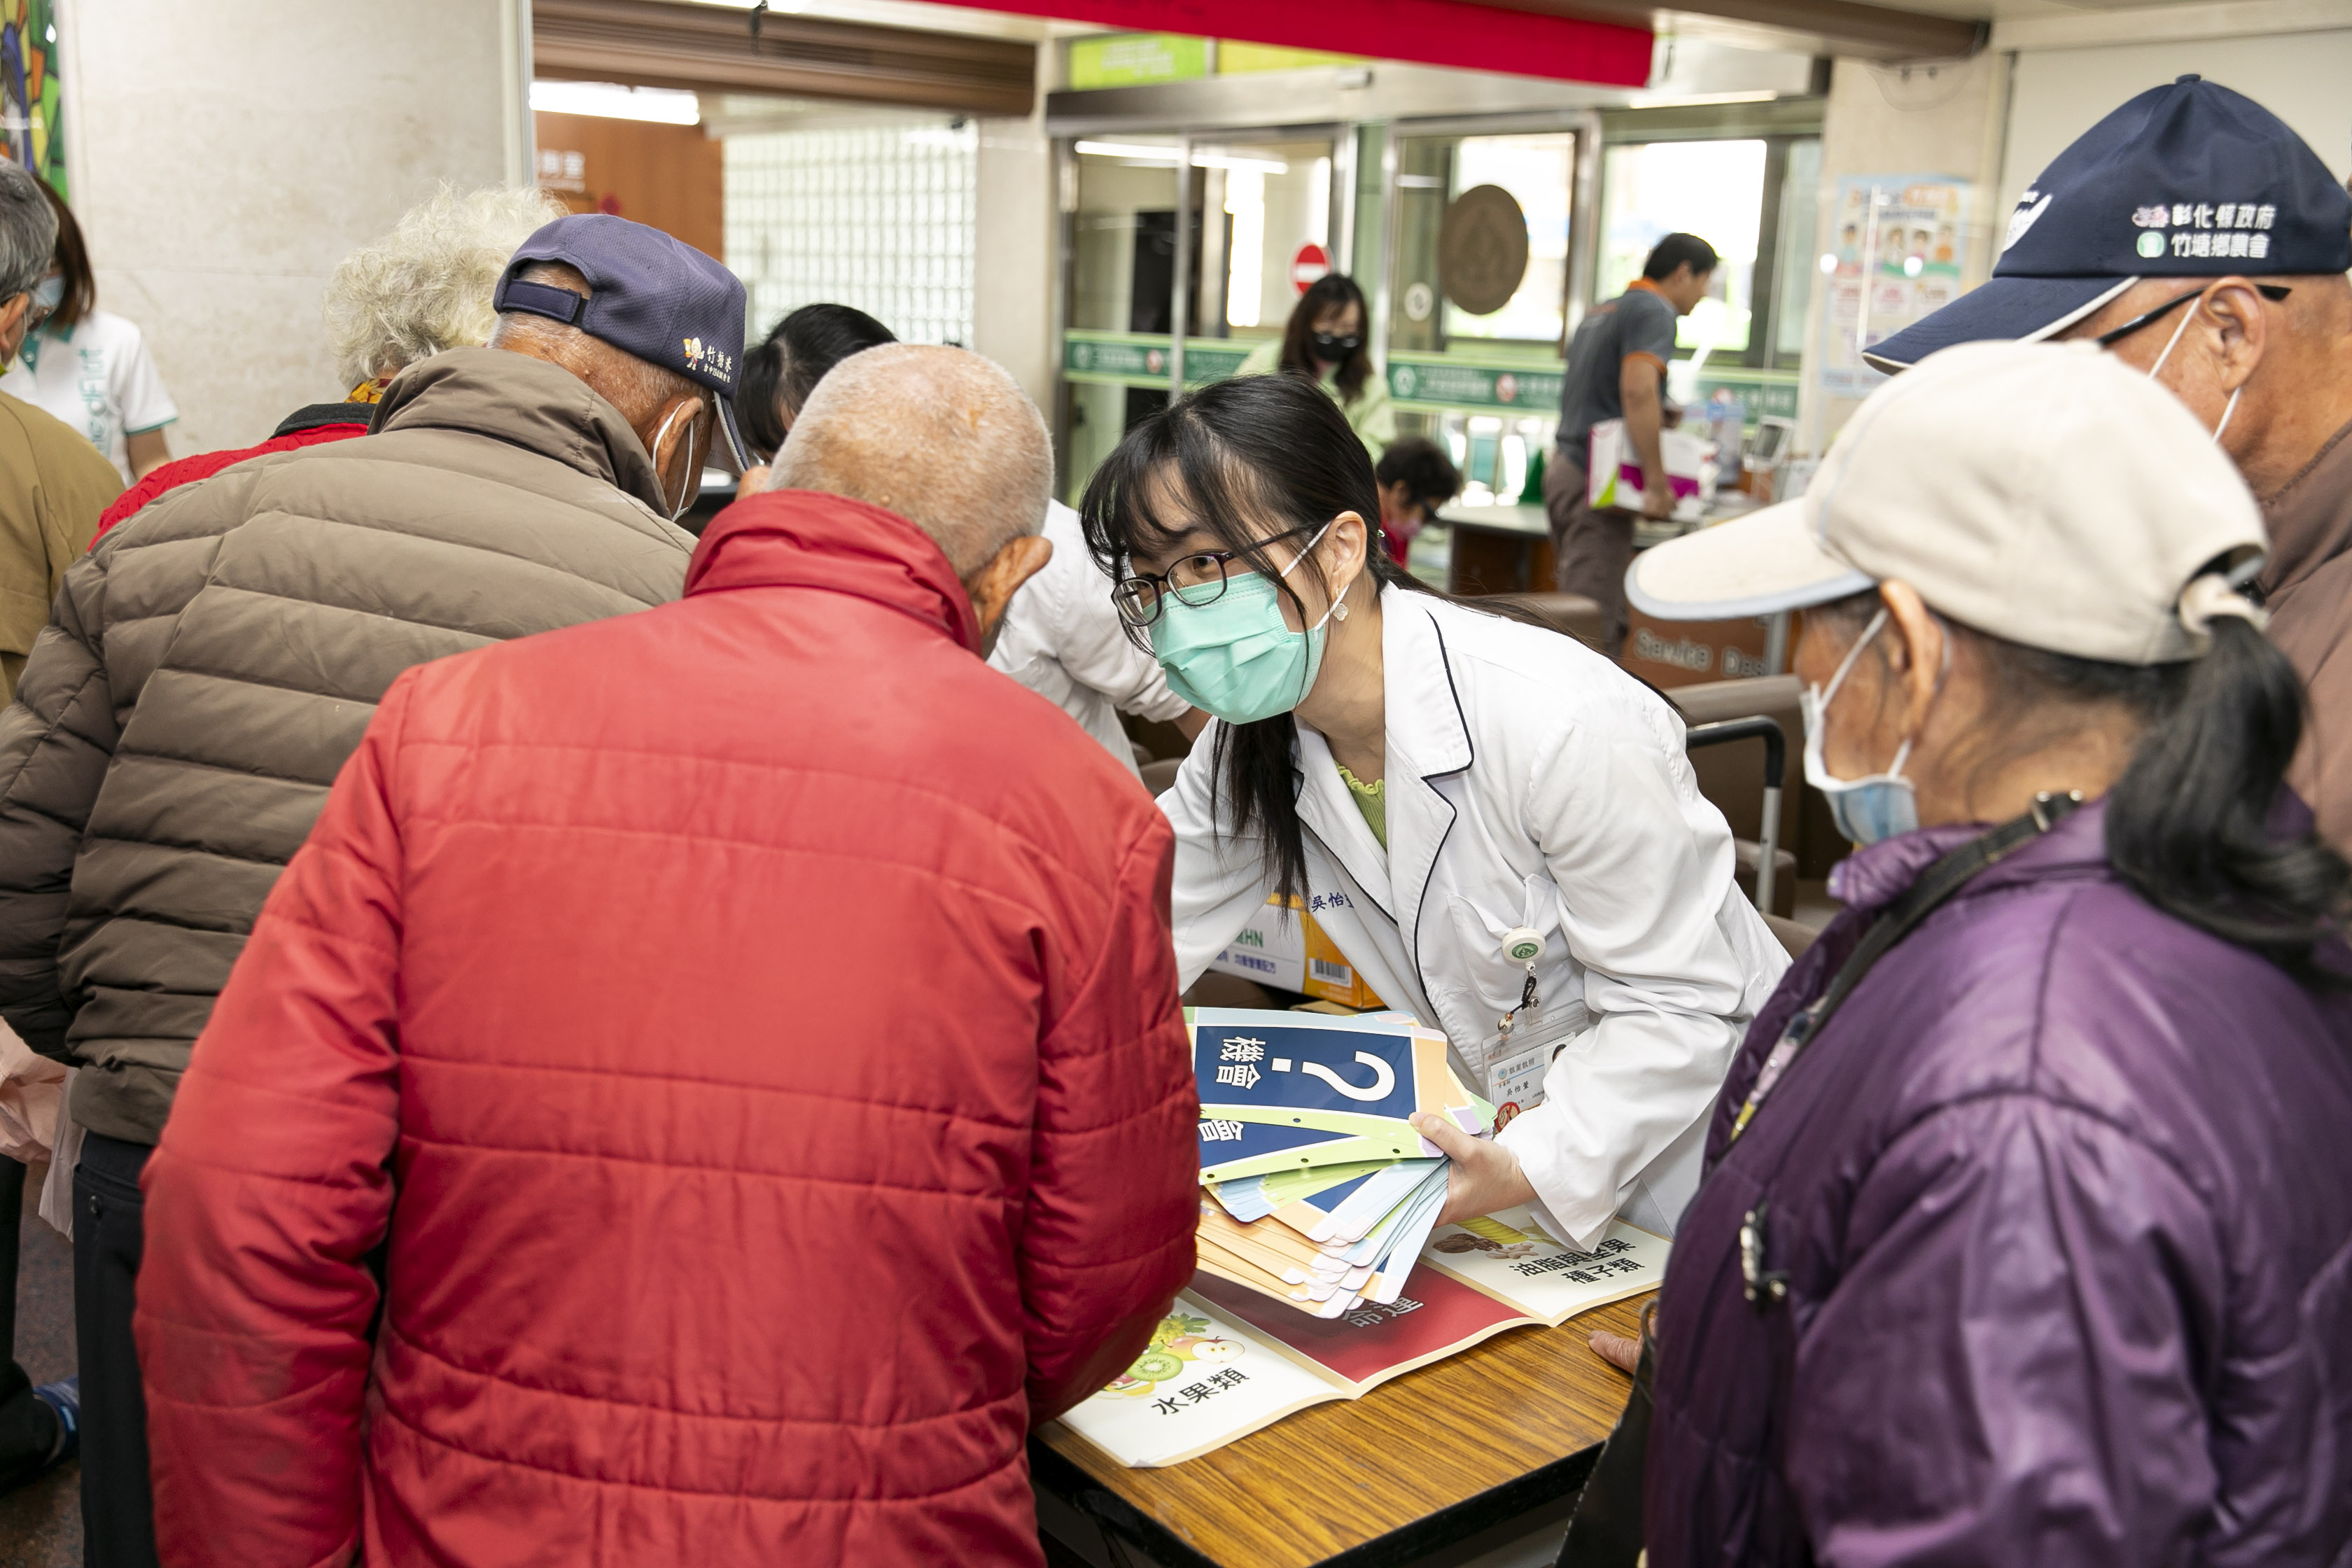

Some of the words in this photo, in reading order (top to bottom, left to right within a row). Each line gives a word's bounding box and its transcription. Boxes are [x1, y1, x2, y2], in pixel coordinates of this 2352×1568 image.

[2171, 203, 2276, 230] 彰化縣政府
[2171, 232, 2269, 258] 竹塘鄉農會
[1634, 629, 1712, 672] Service
[1721, 647, 1769, 677] Des
[1215, 1036, 1266, 1090] 機會
[1560, 1257, 1645, 1284] 種子類
[1151, 1367, 1250, 1415] 水果類
